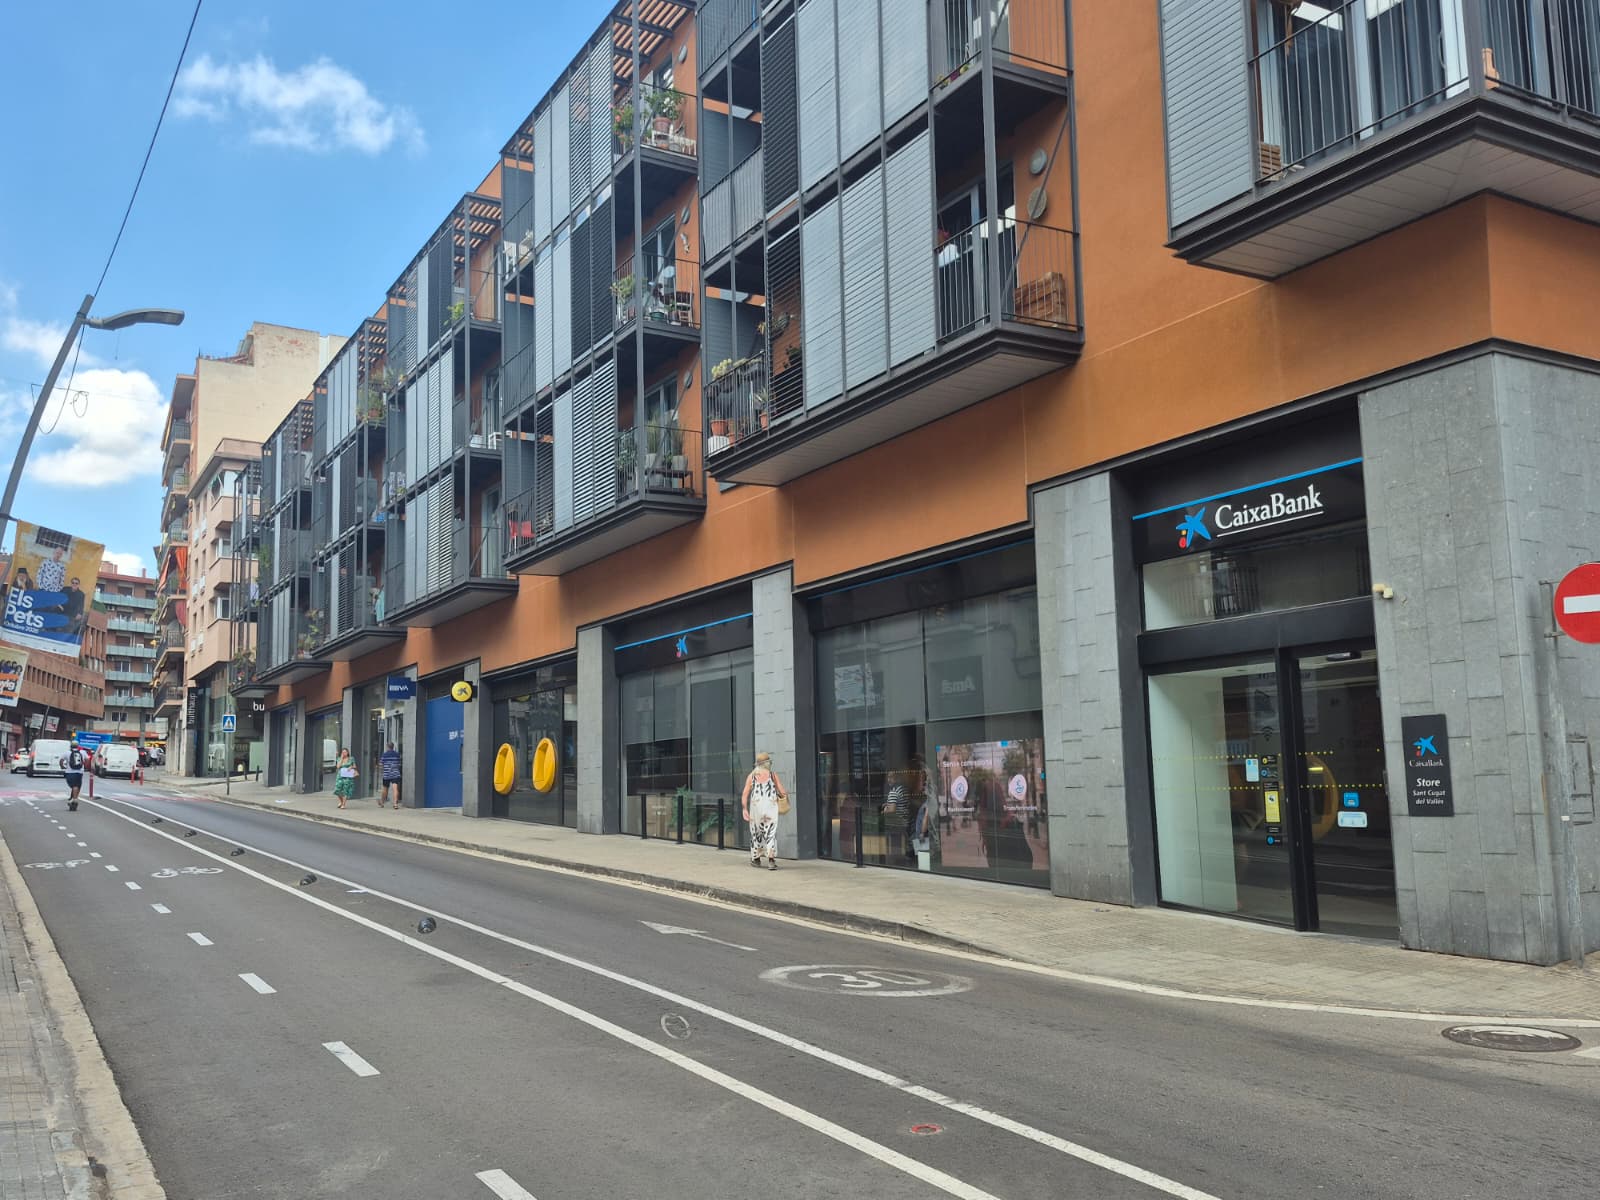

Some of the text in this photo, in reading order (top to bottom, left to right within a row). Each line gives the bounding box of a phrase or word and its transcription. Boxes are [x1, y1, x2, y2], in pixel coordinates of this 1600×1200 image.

[1214, 483, 1324, 530] CaixaBank
[8, 586, 34, 609] Els
[4, 603, 45, 629] Pets
[1416, 777, 1441, 787] Store
[1427, 789, 1446, 797] Cugat
[807, 970, 931, 989] 30
